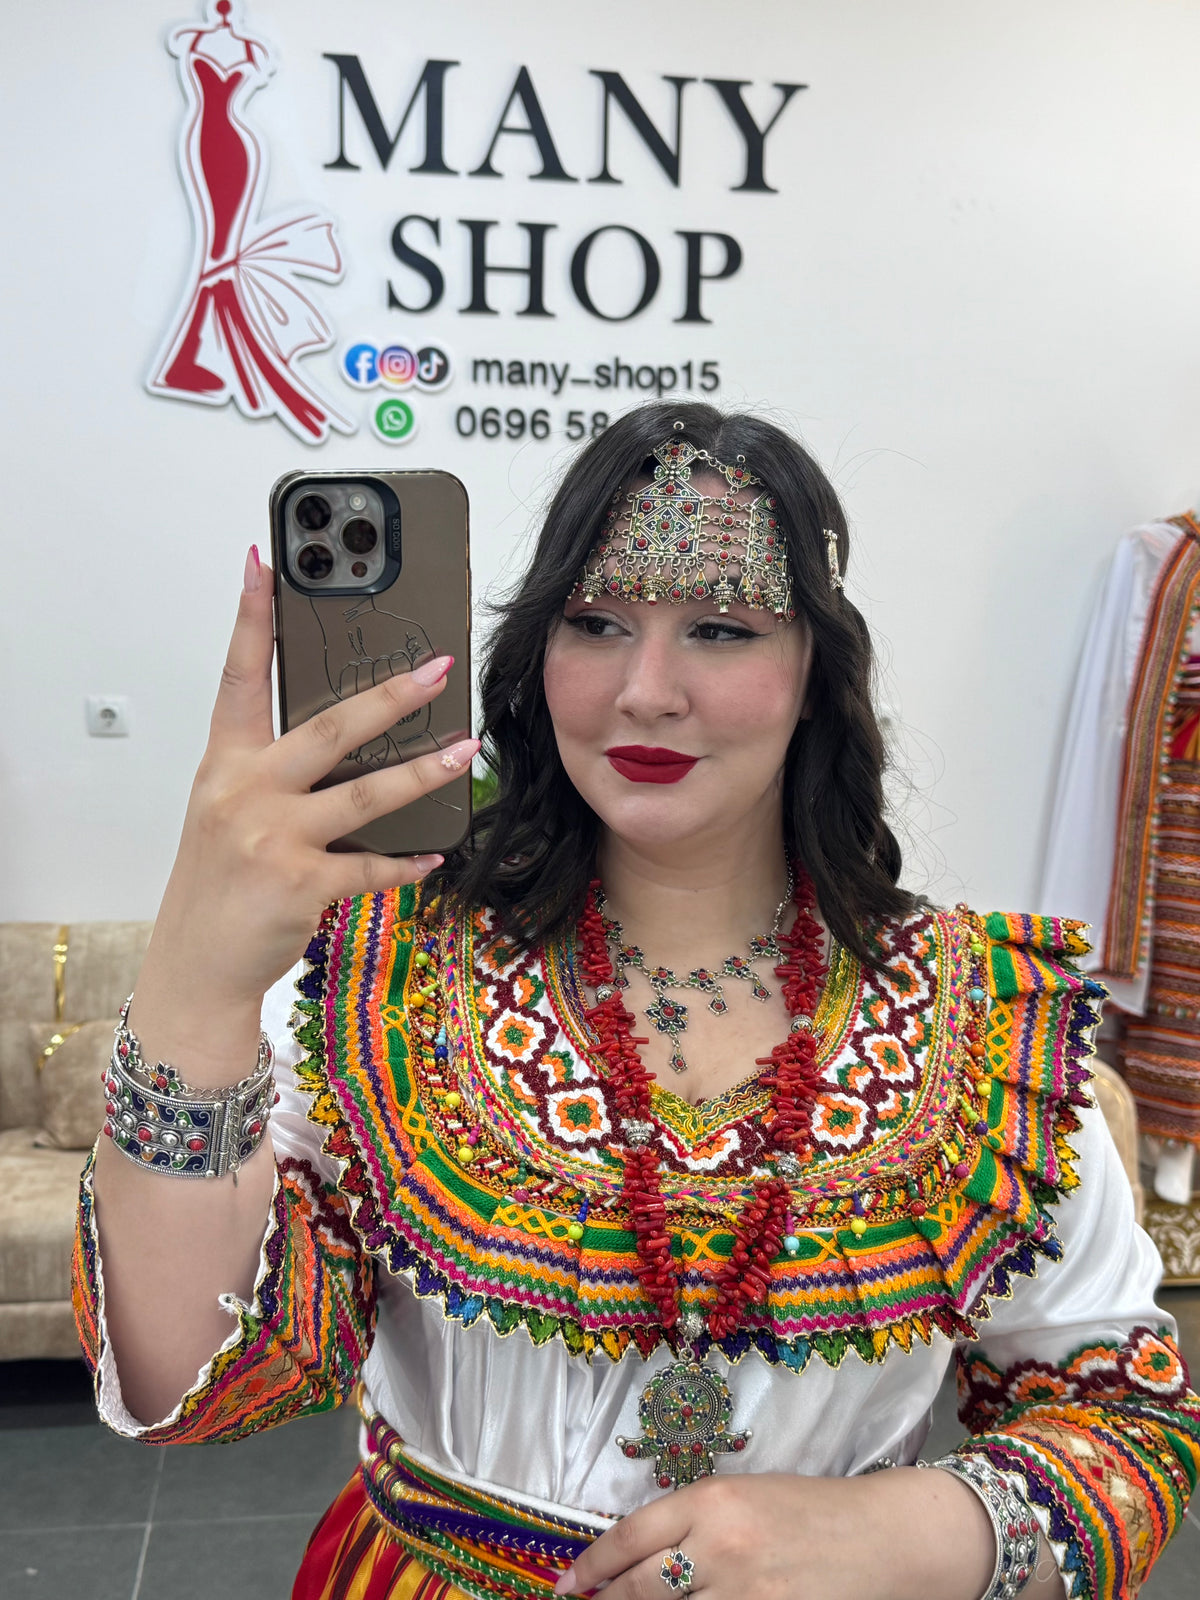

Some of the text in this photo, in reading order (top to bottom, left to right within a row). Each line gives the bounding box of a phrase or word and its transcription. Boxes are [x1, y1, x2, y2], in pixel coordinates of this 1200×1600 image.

[322, 53, 809, 194] MANY
[387, 214, 743, 325] SHOP
[456, 406, 608, 441] 0696 58
